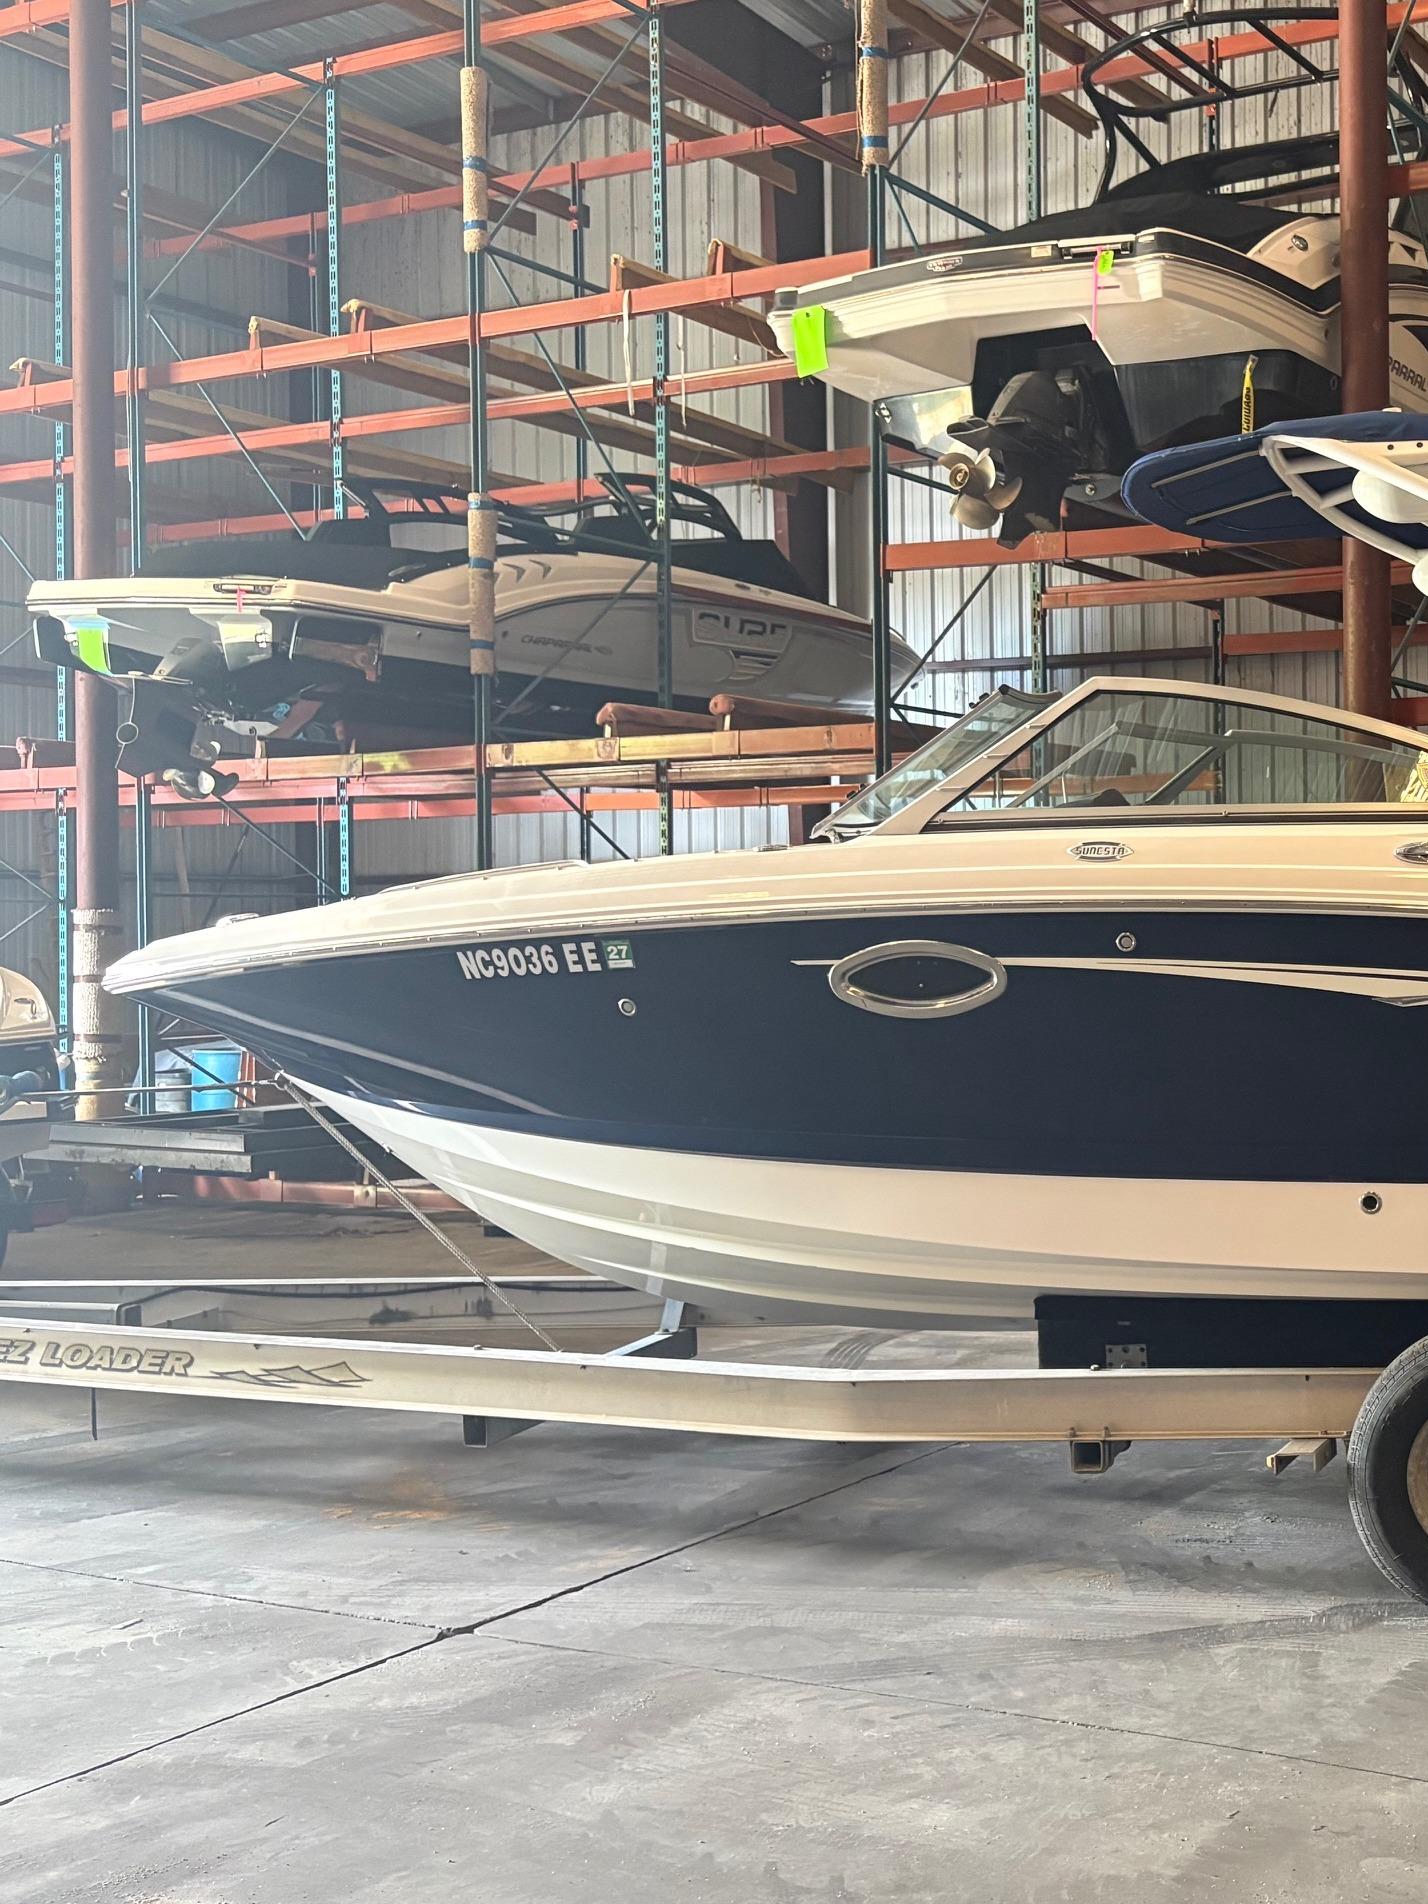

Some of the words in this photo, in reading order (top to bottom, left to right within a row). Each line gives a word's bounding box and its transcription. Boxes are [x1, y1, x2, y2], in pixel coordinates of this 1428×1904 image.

[456, 943, 559, 980] NC9036
[562, 941, 602, 973] EE
[607, 945, 628, 959] 27
[40, 1341, 195, 1377] LOADER
